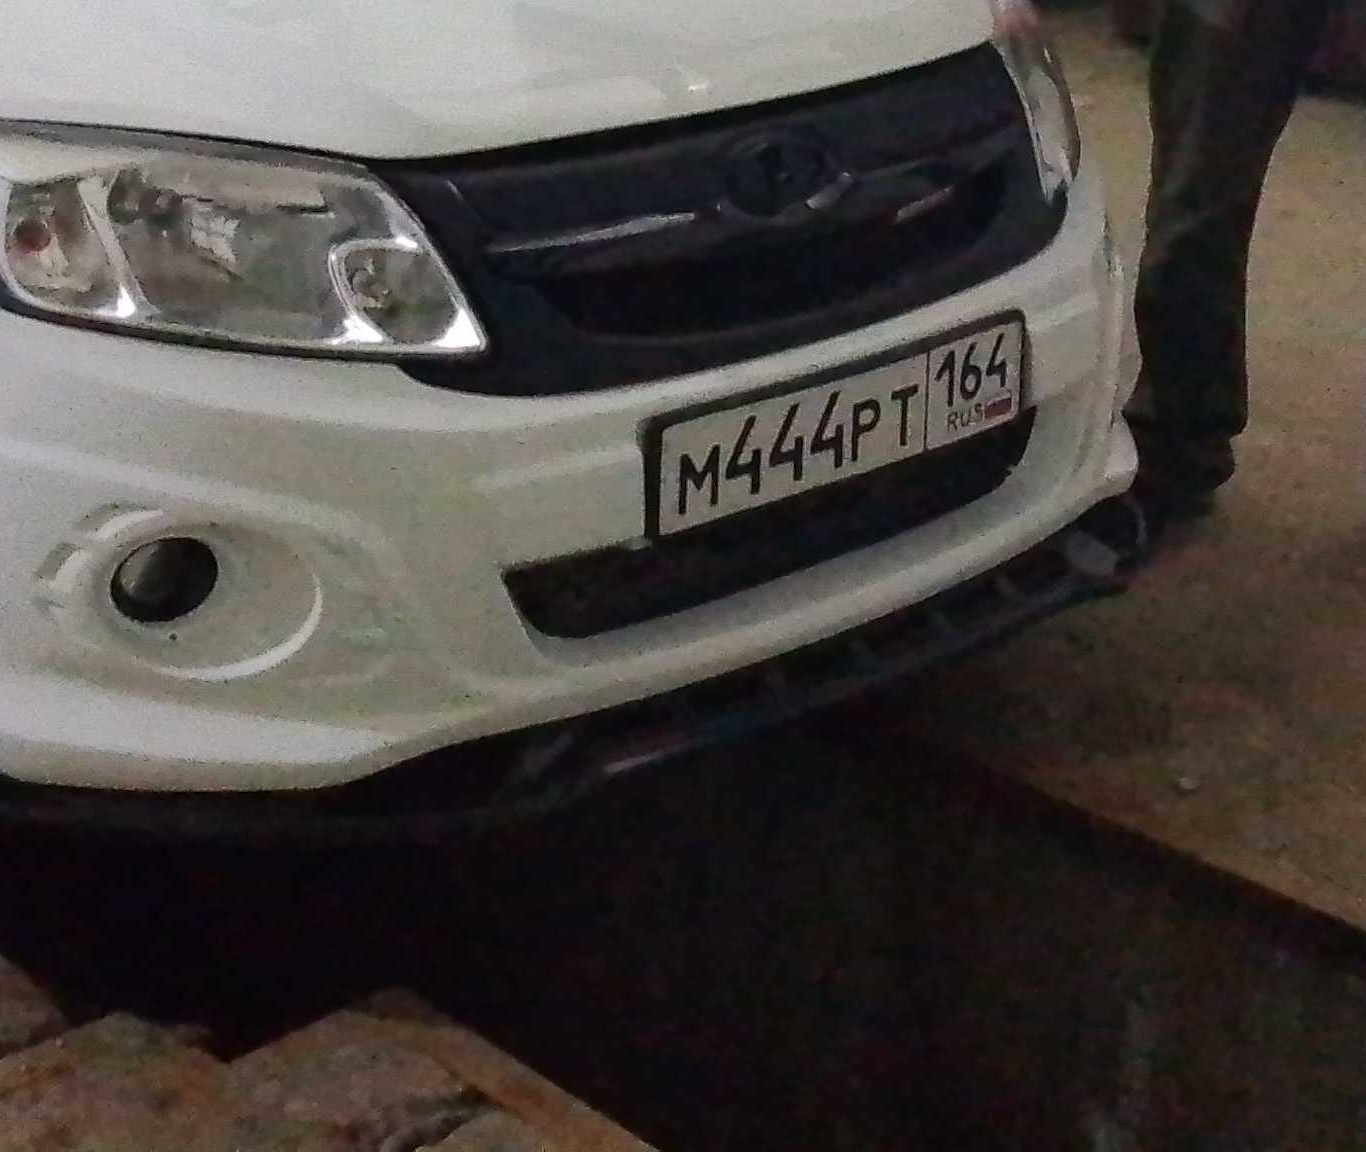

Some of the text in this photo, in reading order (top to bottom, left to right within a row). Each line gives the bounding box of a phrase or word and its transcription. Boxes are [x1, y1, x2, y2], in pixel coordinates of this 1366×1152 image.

[677, 332, 1010, 516] М444РТ 164
[946, 402, 984, 433] RUS
